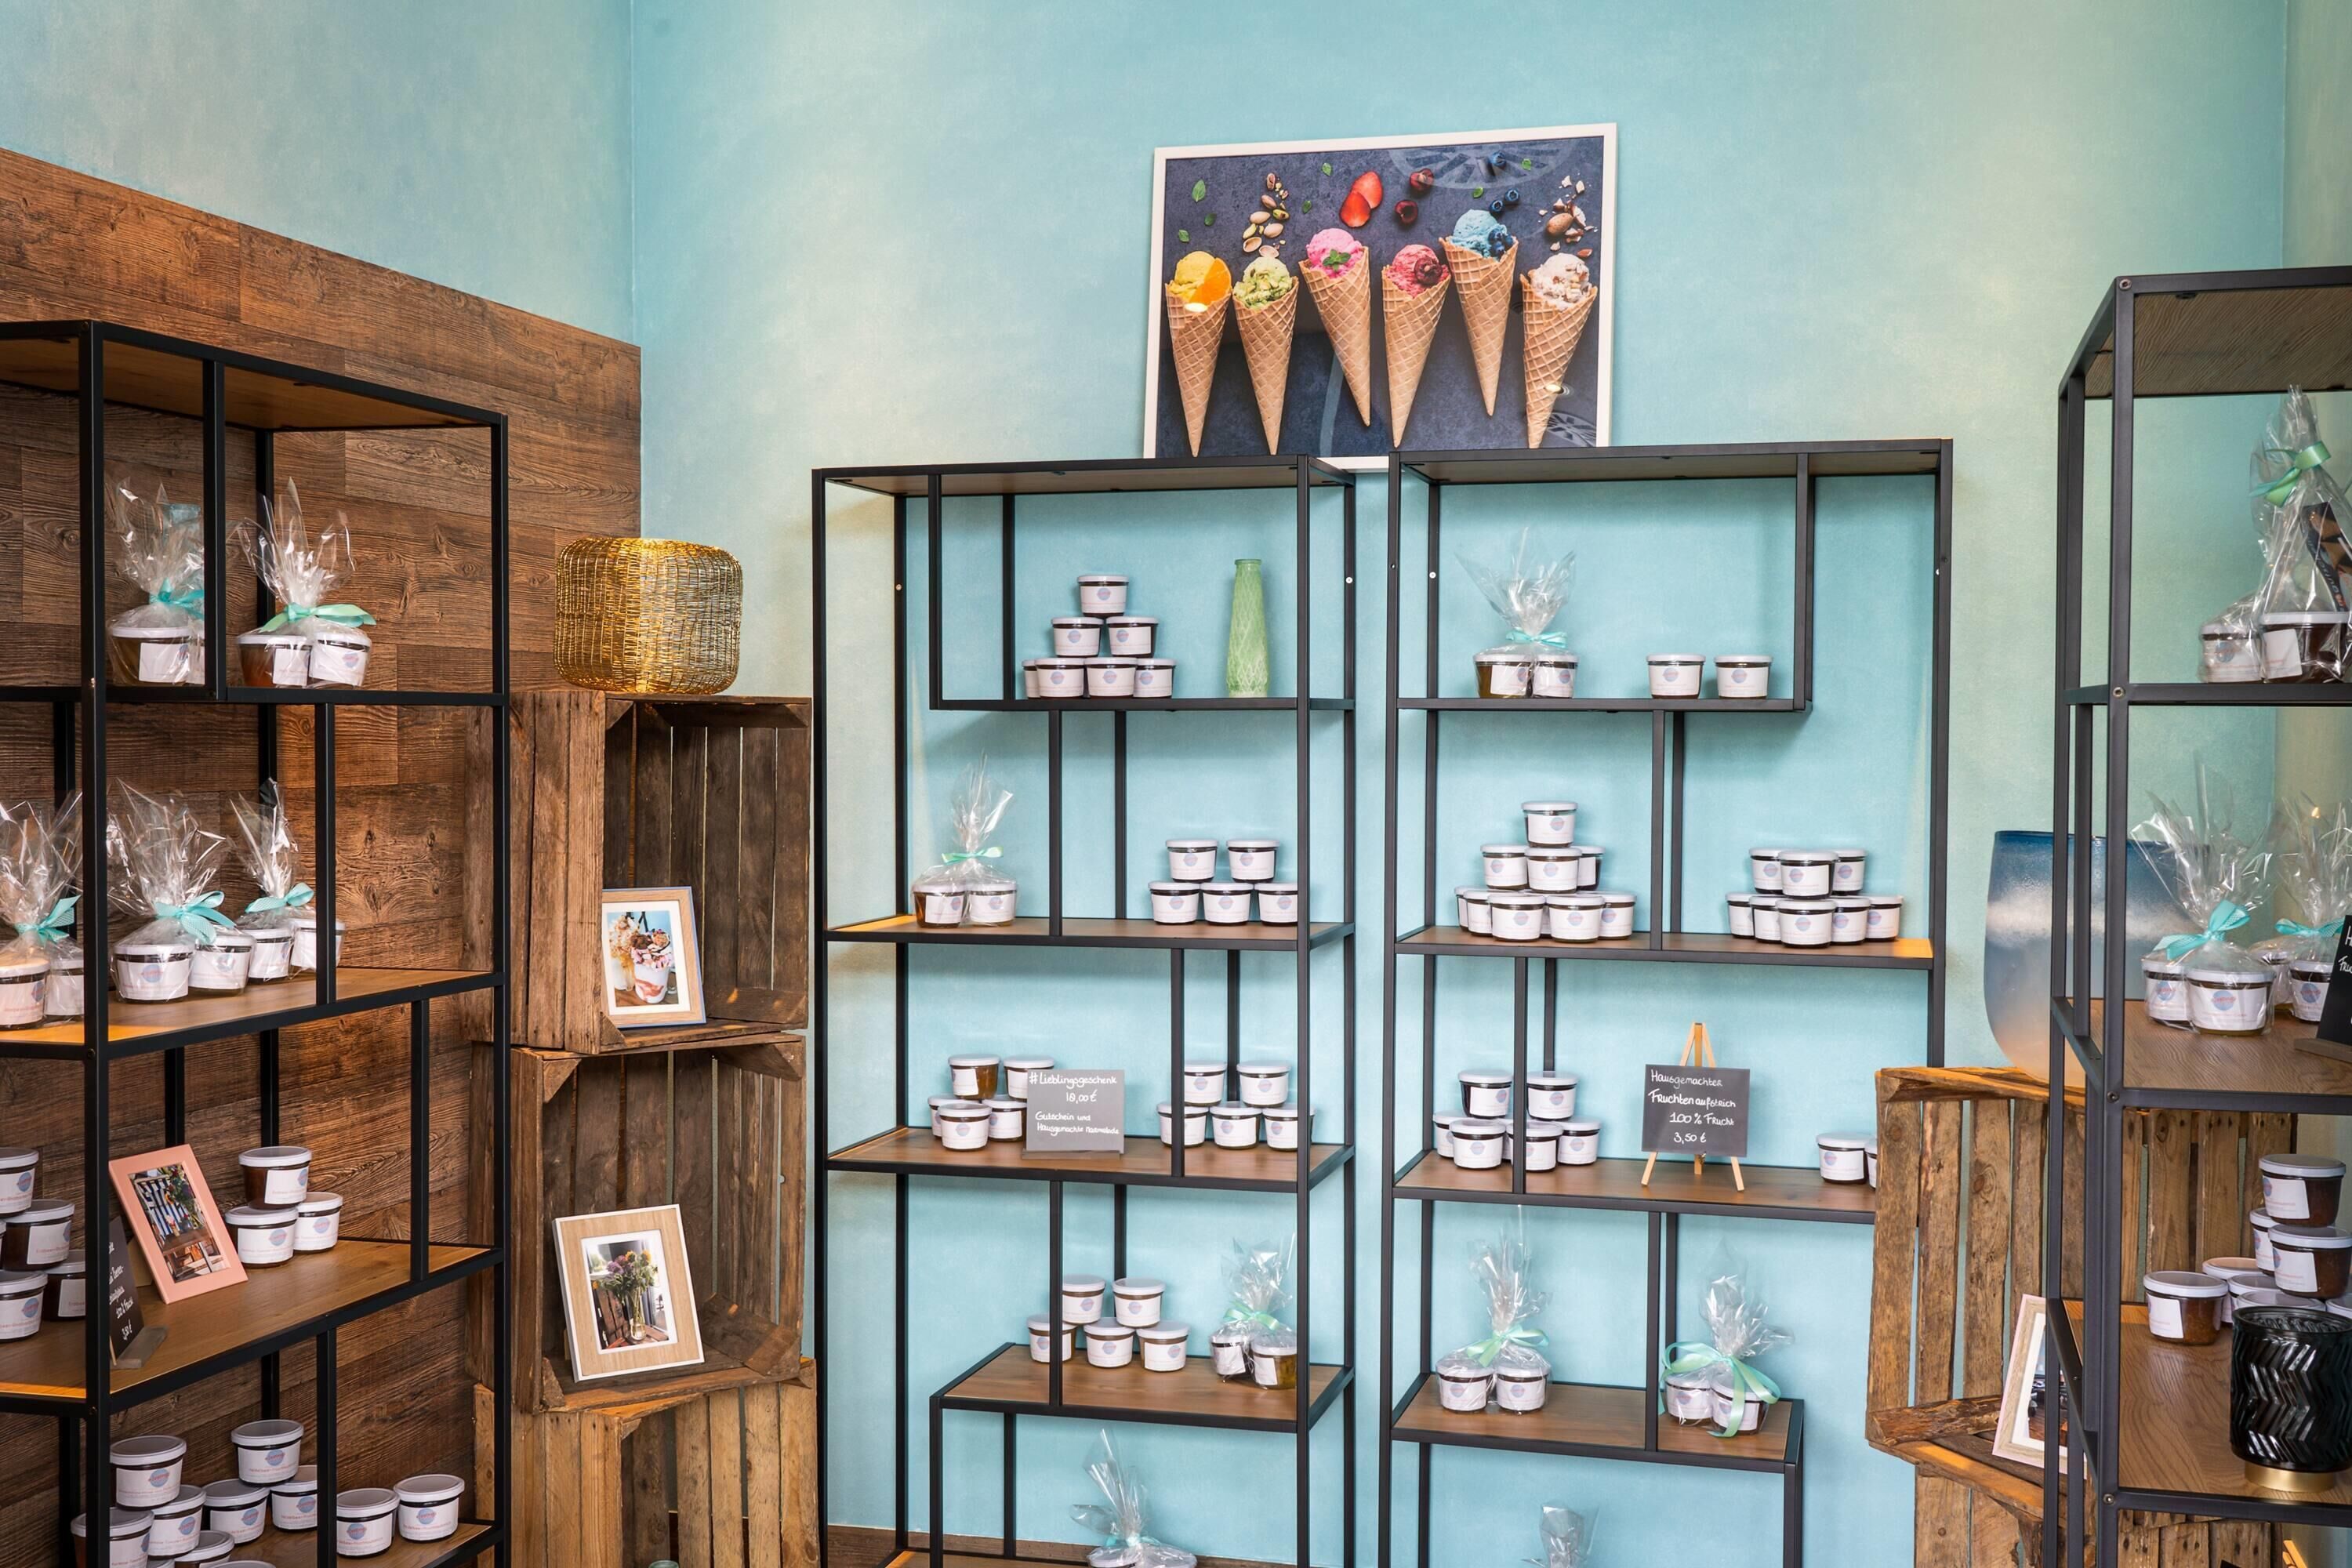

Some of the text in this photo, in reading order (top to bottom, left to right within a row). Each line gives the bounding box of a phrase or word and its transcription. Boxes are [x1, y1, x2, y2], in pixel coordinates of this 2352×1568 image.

[1650, 1069, 1722, 1089] Hausgemachter
[1035, 1110, 1074, 1121] Gutschein
[1669, 1112, 1692, 1123] 100
[1704, 1112, 1734, 1126] Frucht
[1674, 1131, 1697, 1145] 3,50
